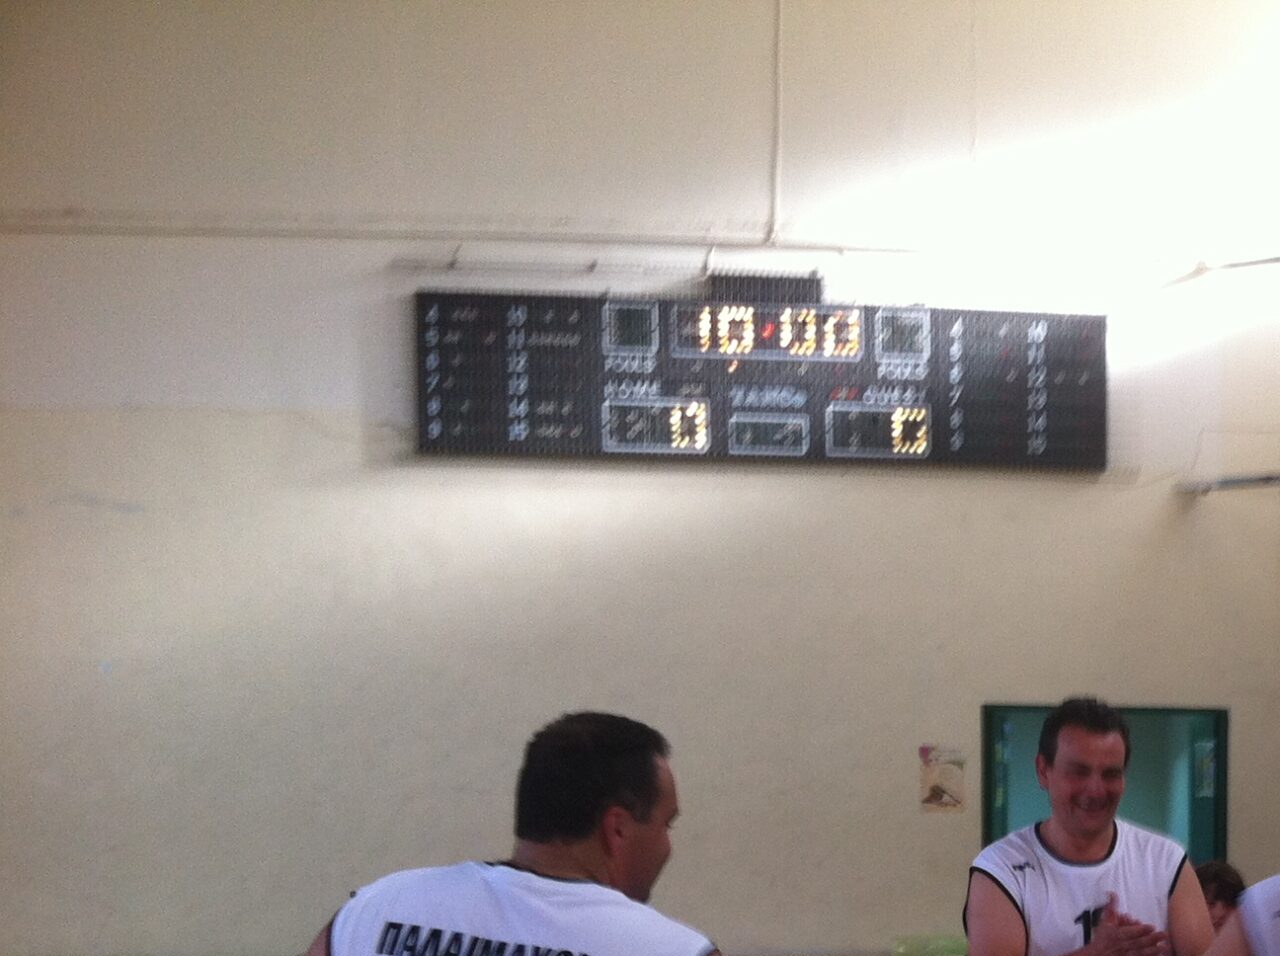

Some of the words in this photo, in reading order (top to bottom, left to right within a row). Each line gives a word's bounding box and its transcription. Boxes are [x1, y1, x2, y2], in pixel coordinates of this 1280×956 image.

[604, 380, 661, 399] HOME
[669, 401, 707, 450] 0
[891, 407, 928, 454] 0
